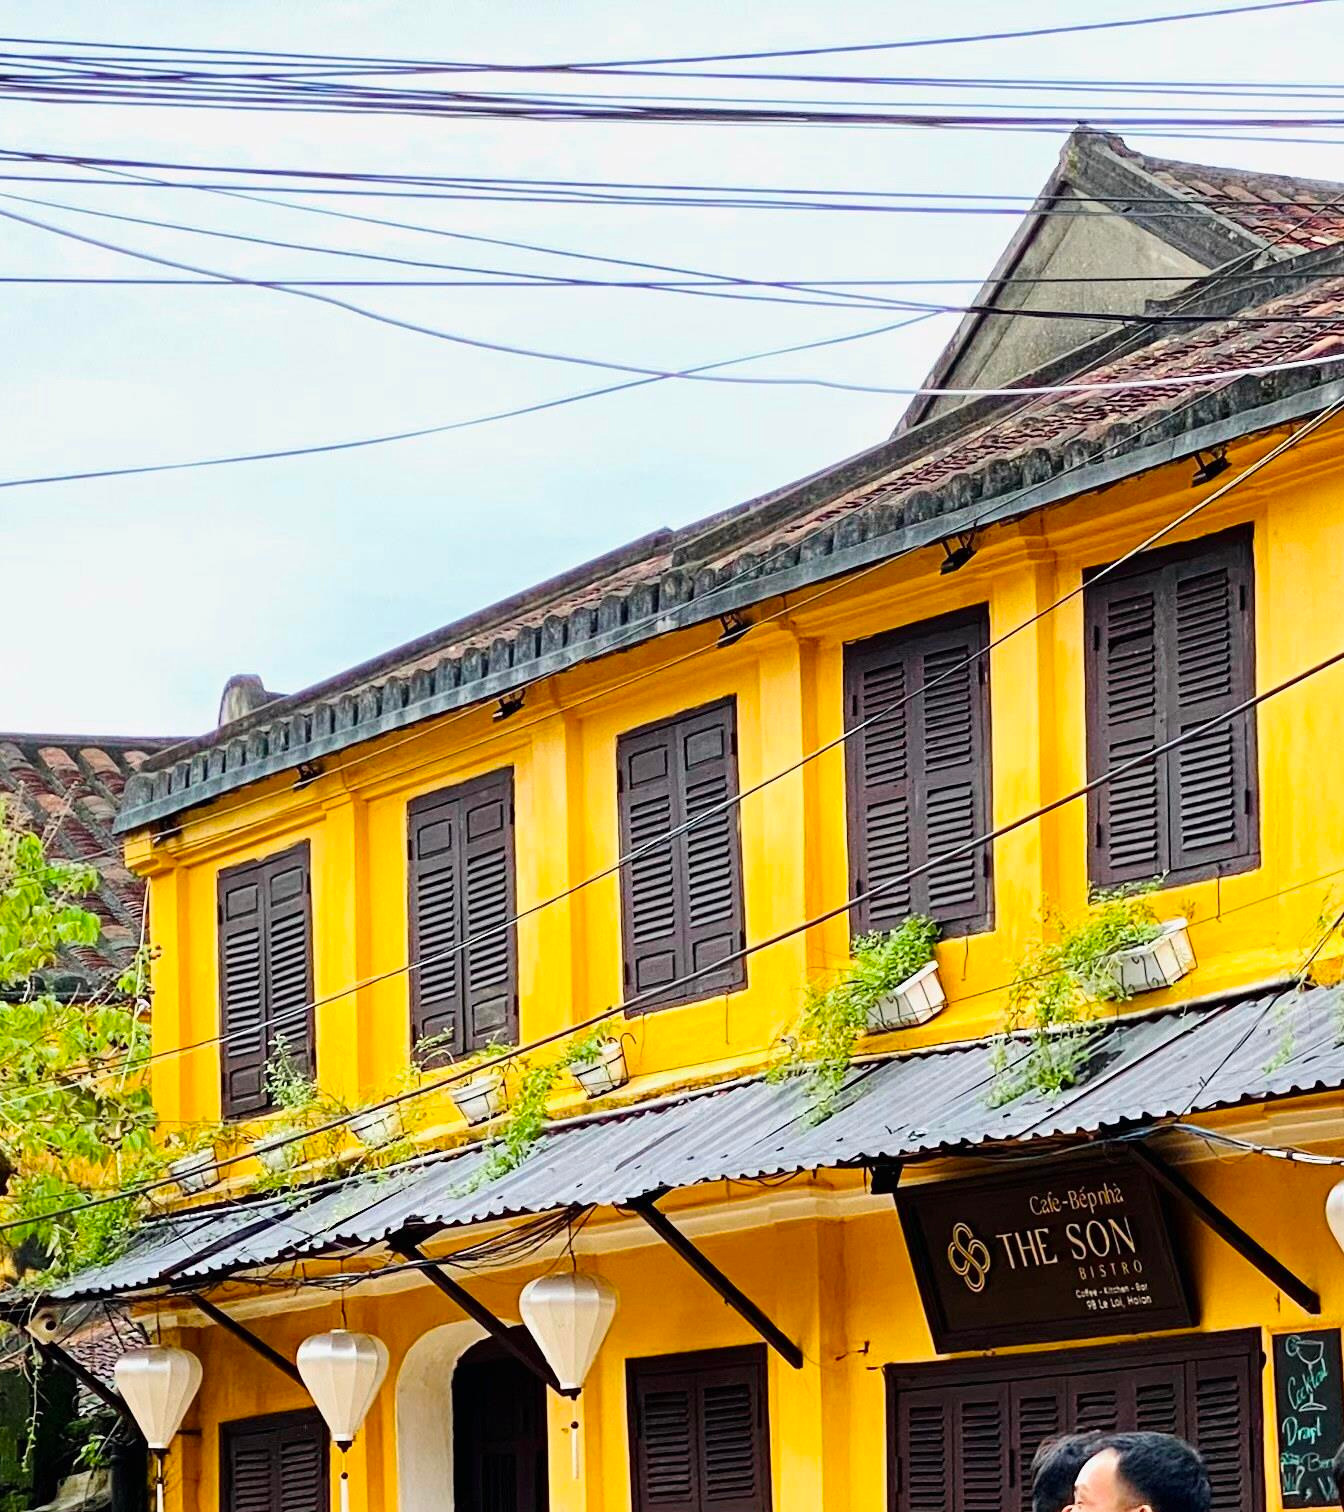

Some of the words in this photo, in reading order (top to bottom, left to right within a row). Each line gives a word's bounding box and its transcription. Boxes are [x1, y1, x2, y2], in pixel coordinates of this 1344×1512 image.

[995, 1228, 1058, 1269] THE
[1065, 1216, 1136, 1260] SON
[1078, 1260, 1143, 1280] BISTRO
